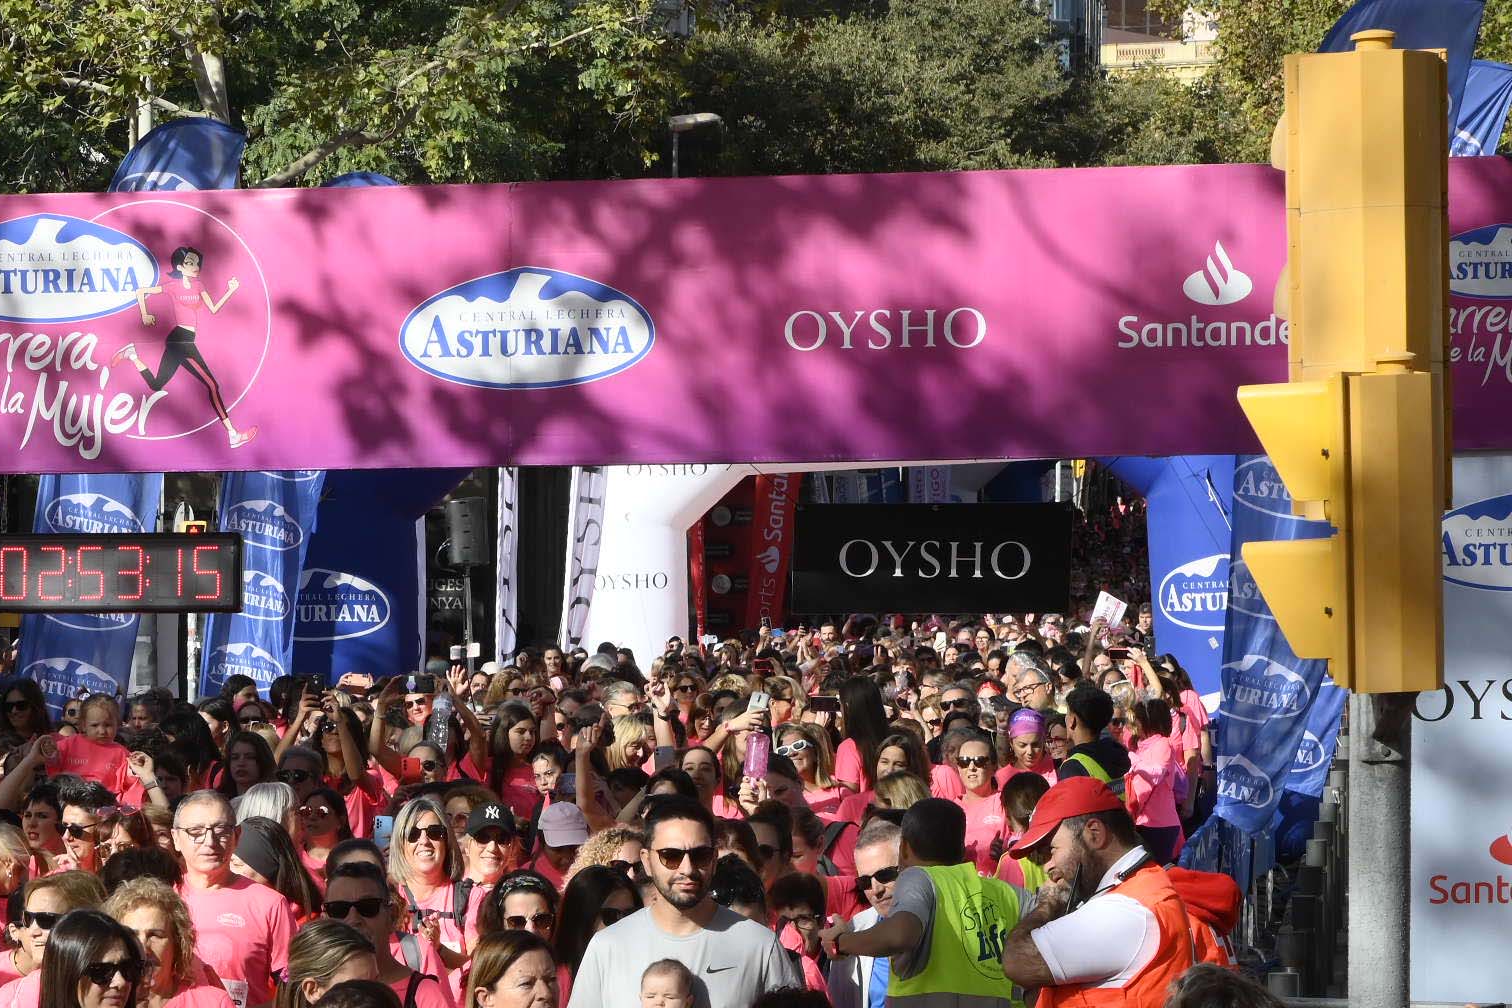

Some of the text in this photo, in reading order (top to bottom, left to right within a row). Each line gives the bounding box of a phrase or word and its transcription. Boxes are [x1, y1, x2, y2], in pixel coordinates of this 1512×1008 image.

[62, 251, 134, 262] LECHERA
[459, 307, 625, 322] CENTRAL LECHERA
[783, 307, 986, 352] OYSHO
[420, 314, 634, 358] ASTURIANA
[0, 374, 24, 414] la
[20, 366, 169, 460] Mujer
[0, 546, 220, 600] 02:53:15
[840, 539, 1032, 580] OYSHO
[1429, 875, 1512, 904] Sant
